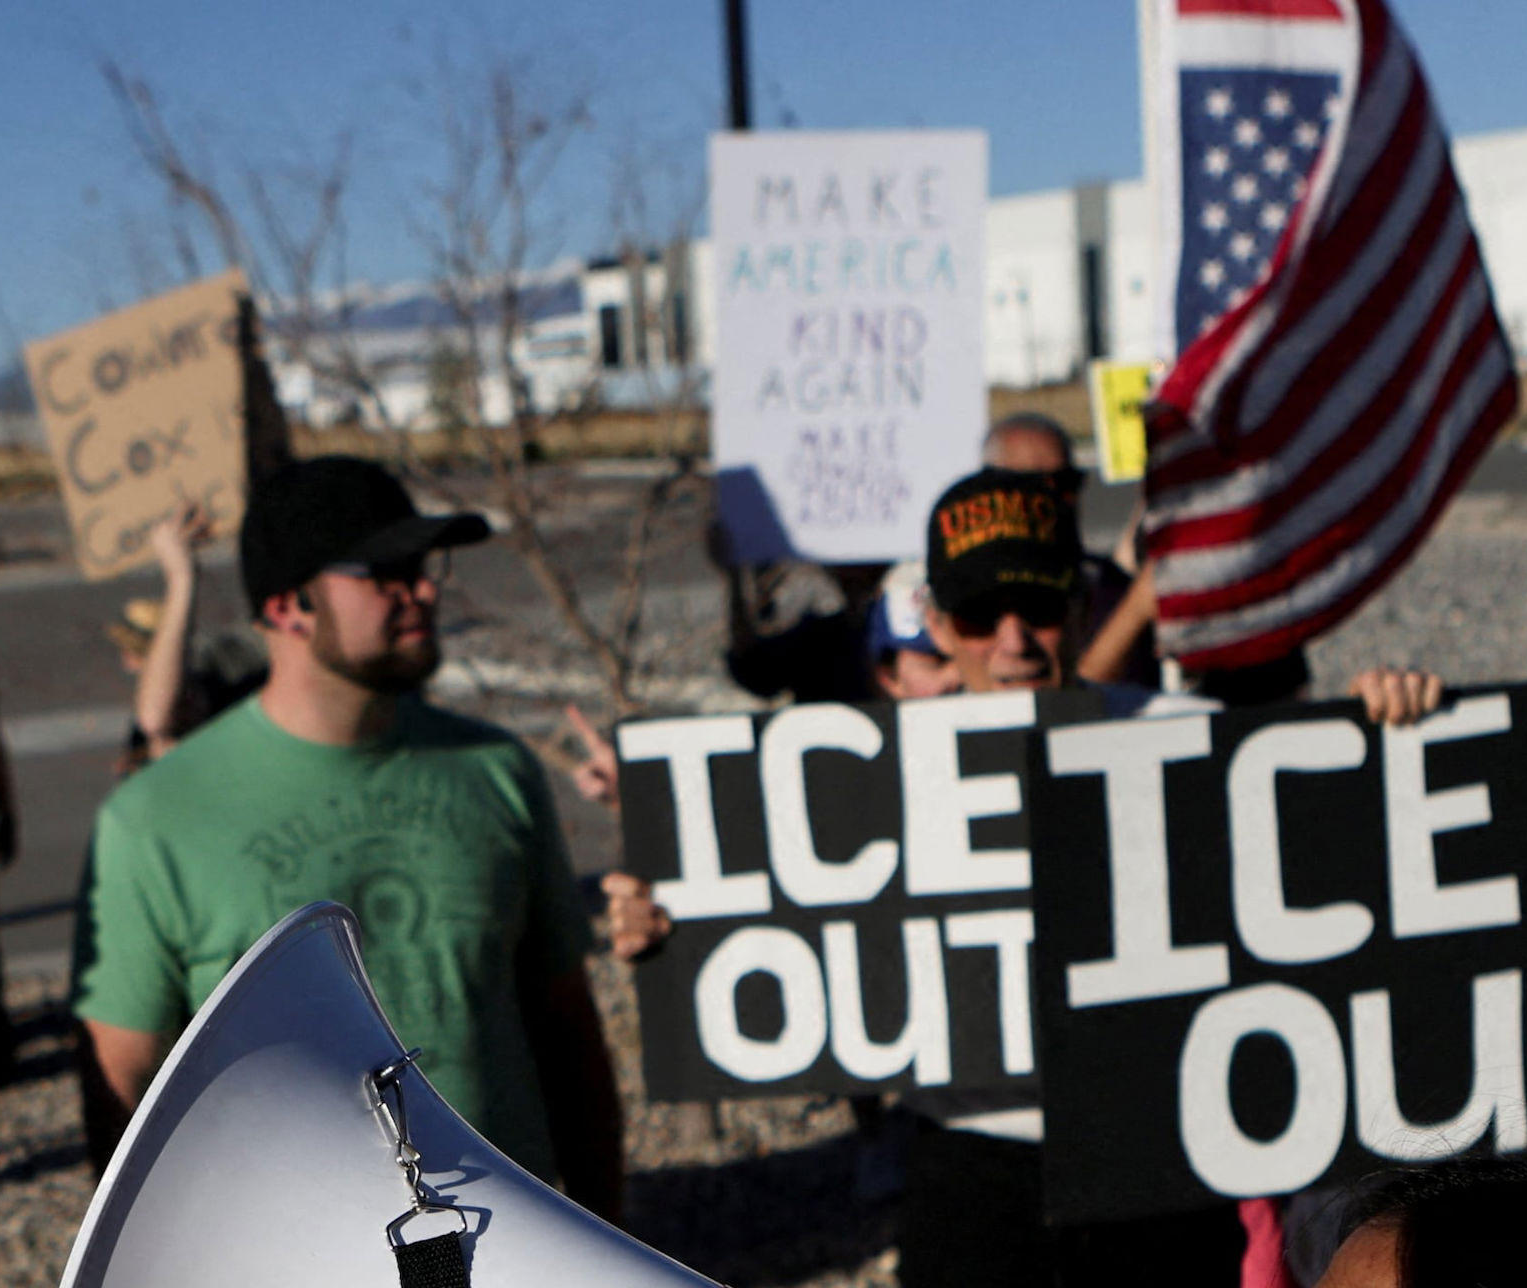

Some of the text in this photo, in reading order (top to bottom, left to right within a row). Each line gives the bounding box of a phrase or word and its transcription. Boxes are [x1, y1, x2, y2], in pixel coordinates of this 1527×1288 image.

[753, 164, 945, 229] MAKE
[726, 233, 957, 296] AMERICA
[787, 305, 928, 358] KIND
[756, 356, 926, 415] AGAIN
[66, 416, 199, 496] Cox
[938, 489, 1056, 539] USMC
[617, 689, 1035, 921] ICE
[1047, 692, 1522, 1008] ICE
[694, 909, 1035, 1086] OUT
